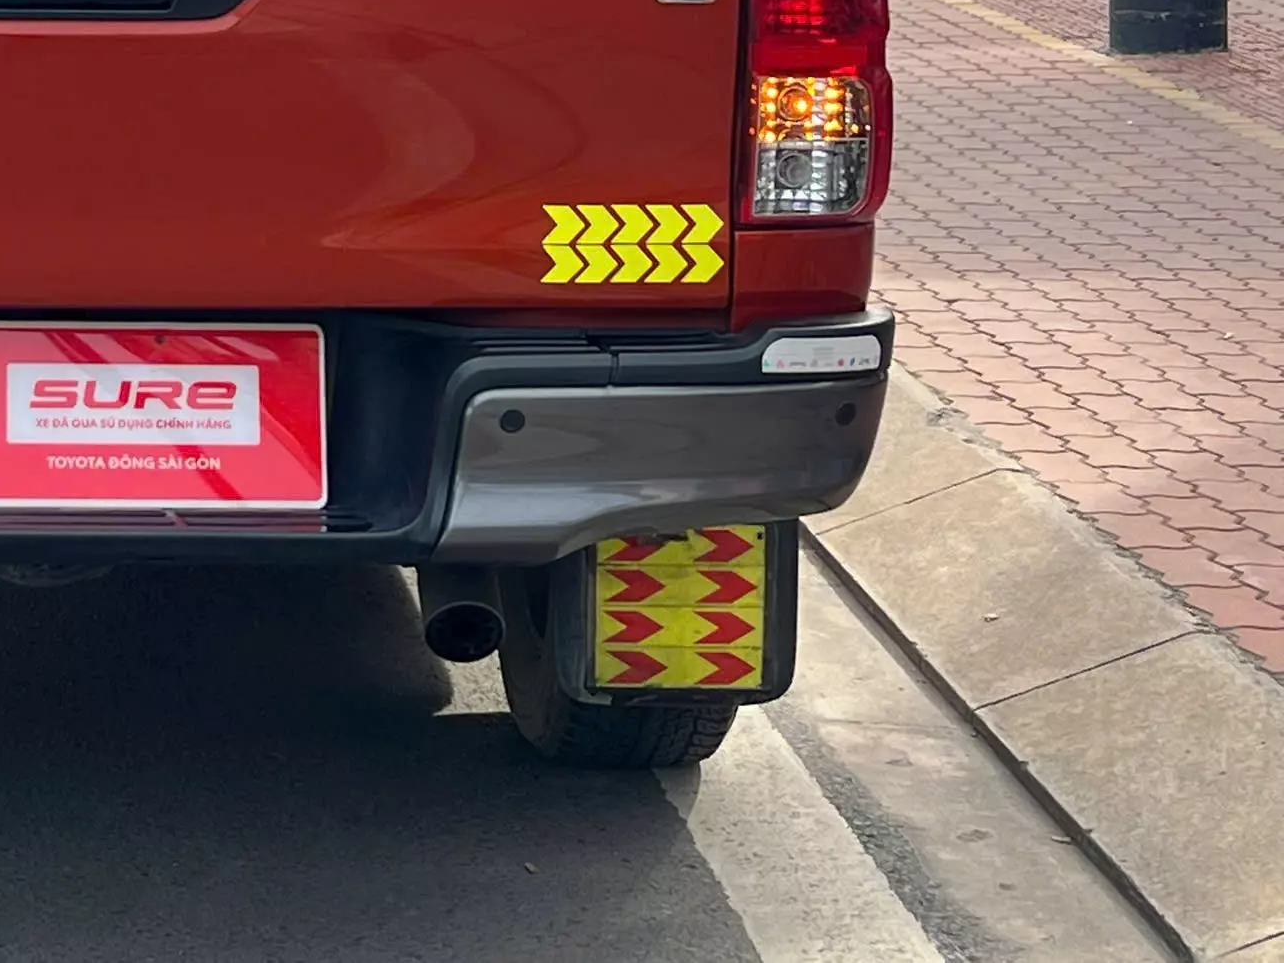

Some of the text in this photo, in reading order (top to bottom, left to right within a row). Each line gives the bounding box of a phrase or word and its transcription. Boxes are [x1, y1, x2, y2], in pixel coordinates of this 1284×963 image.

[36, 417, 50, 429] XE
[71, 417, 98, 430] QUA
[118, 417, 154, 432] DỤNG
[155, 416, 194, 430] CHÍNH
[47, 453, 221, 471] TOYOTA ĐÔNG SÀI GÒN
